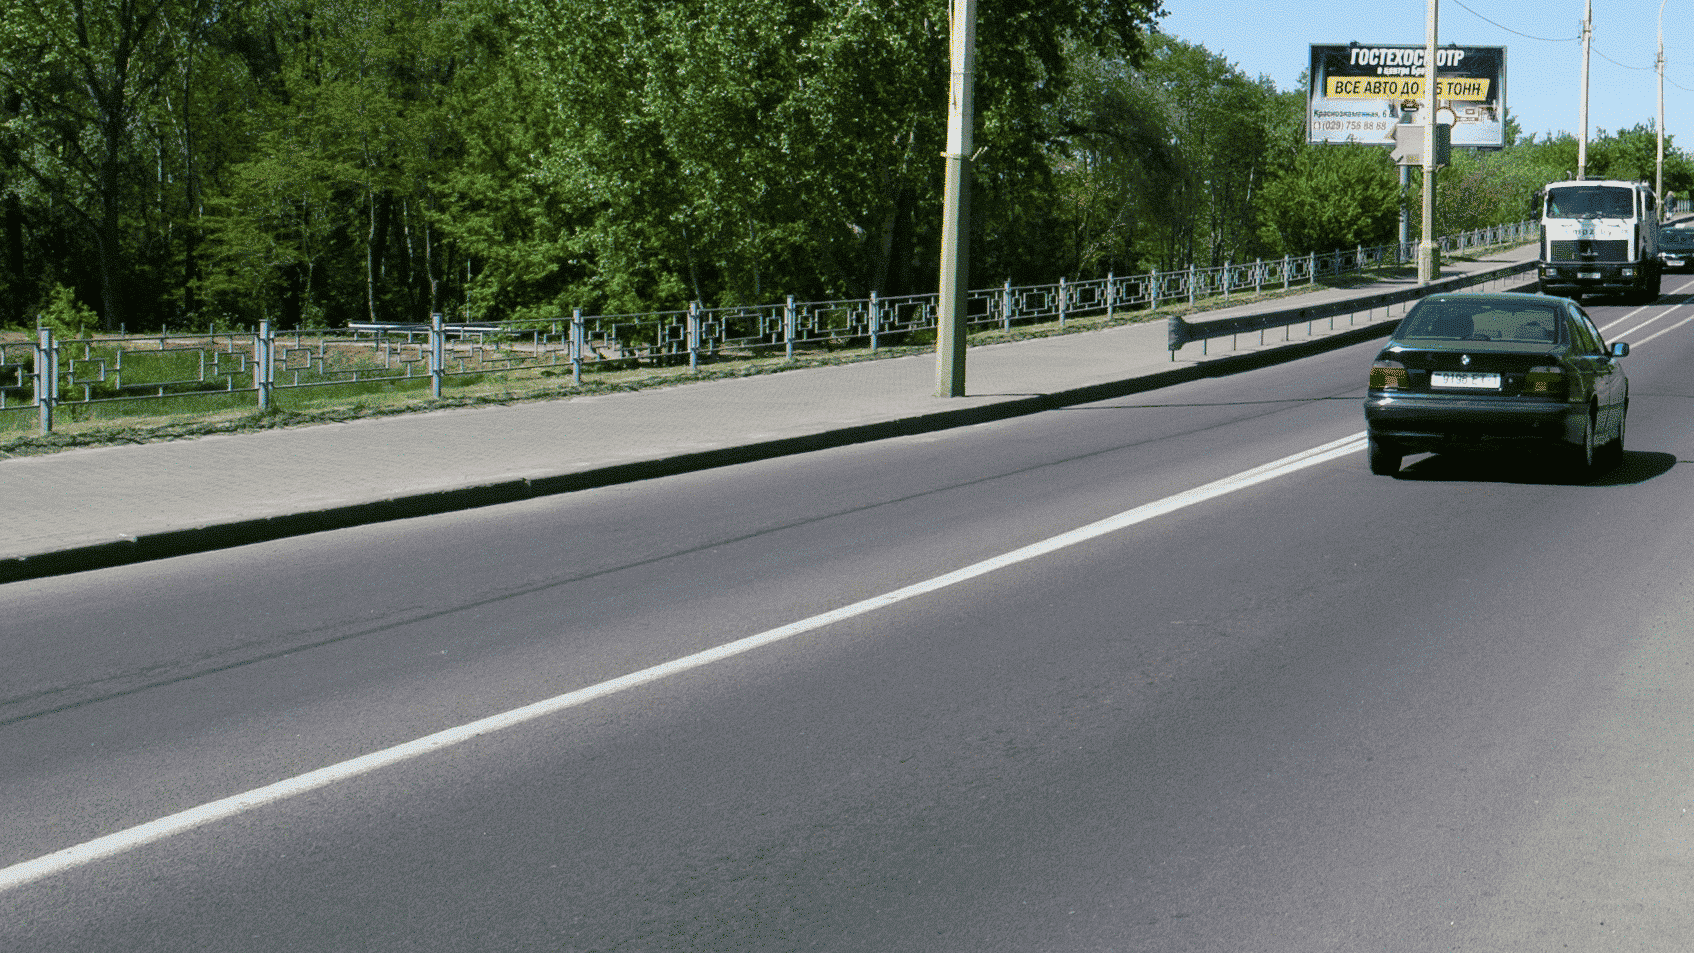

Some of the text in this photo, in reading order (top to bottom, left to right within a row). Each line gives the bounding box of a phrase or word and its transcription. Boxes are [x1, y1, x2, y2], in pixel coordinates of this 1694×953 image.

[1350, 48, 1465, 67] ГОСТЕХОСОТР
[1334, 81, 1361, 95] ВСЕ
[1364, 81, 1398, 95] АВТО
[1400, 82, 1420, 97] ДО
[1447, 82, 1481, 96] ТОНН
